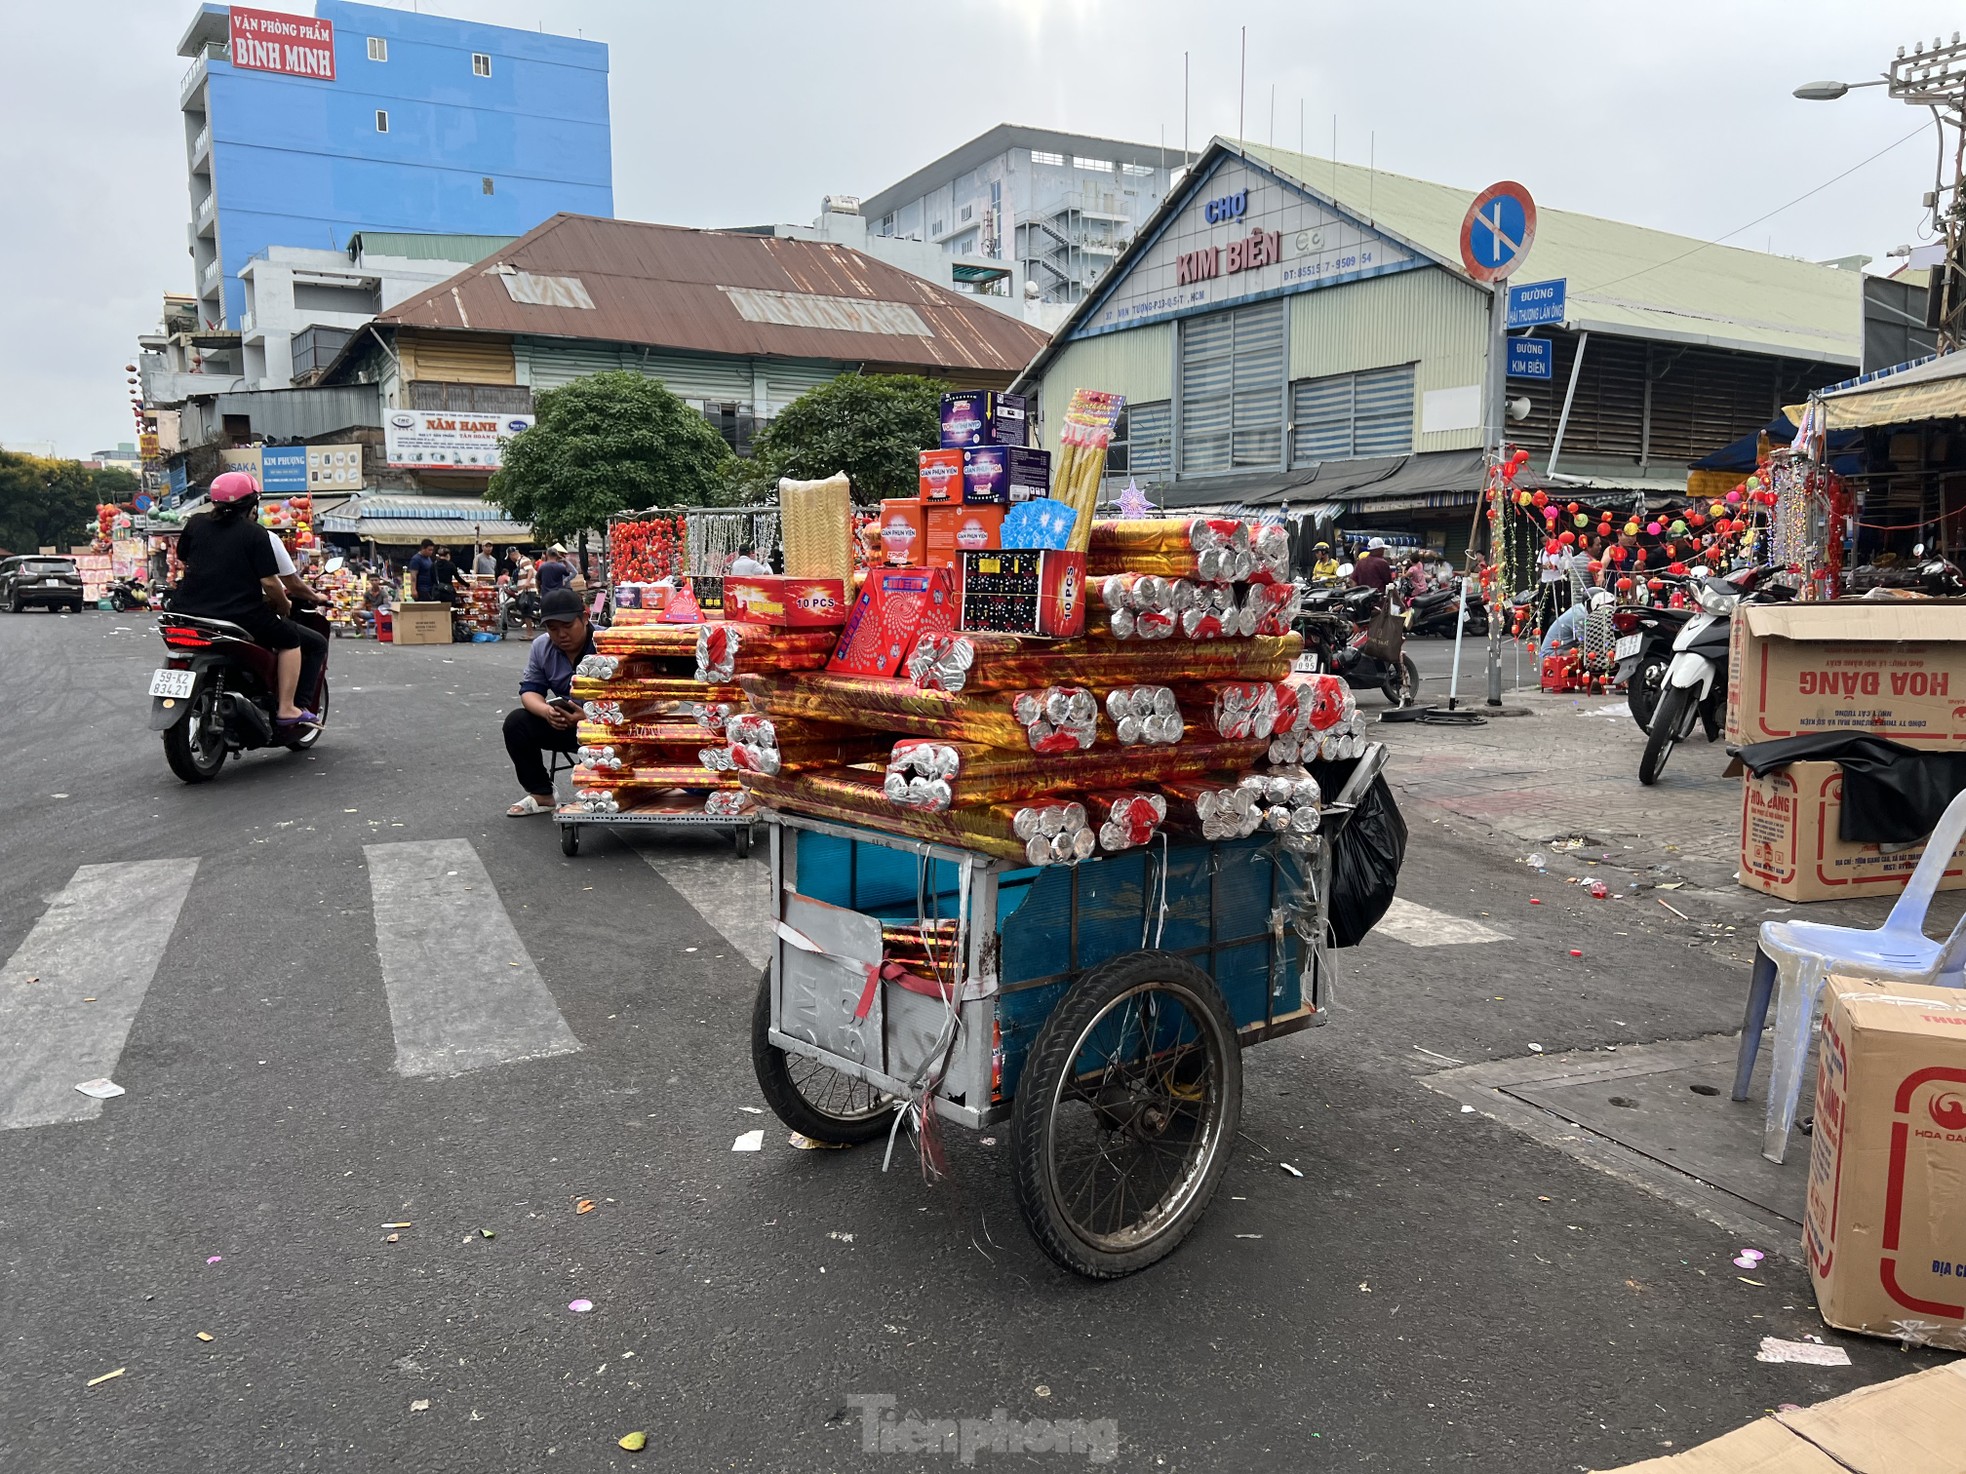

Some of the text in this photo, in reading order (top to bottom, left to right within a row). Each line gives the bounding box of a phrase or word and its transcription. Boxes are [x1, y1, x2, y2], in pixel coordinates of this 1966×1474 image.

[234, 14, 330, 42] VĂN PHÒNG PHẨM
[236, 32, 332, 76] BÌNH MINH
[1205, 187, 1248, 224] CHỢ
[1176, 227, 1280, 286] KIM BIÊN
[1521, 288, 1554, 302] ĐƯỜNG
[1106, 311, 1112, 320] 37
[1509, 306, 1518, 323] HẢI
[1519, 309, 1539, 324] THƯỢNG
[1516, 342, 1543, 354] ĐƯỜNG
[1512, 358, 1546, 374] KIM BIÊN
[426, 418, 456, 430] NĂM
[459, 420, 498, 434] HẠNH
[264, 456, 276, 466] KIM
[1064, 567, 1074, 620] 10 PCS
[798, 598, 835, 608] 10 PCS
[160, 672, 189, 684] 59-K2
[1799, 671, 1949, 700] HOA ĐĂNG
[153, 682, 188, 697] 834.21
[1915, 1130, 1942, 1140] HOA
[1932, 1260, 1952, 1276] ĐỊA
